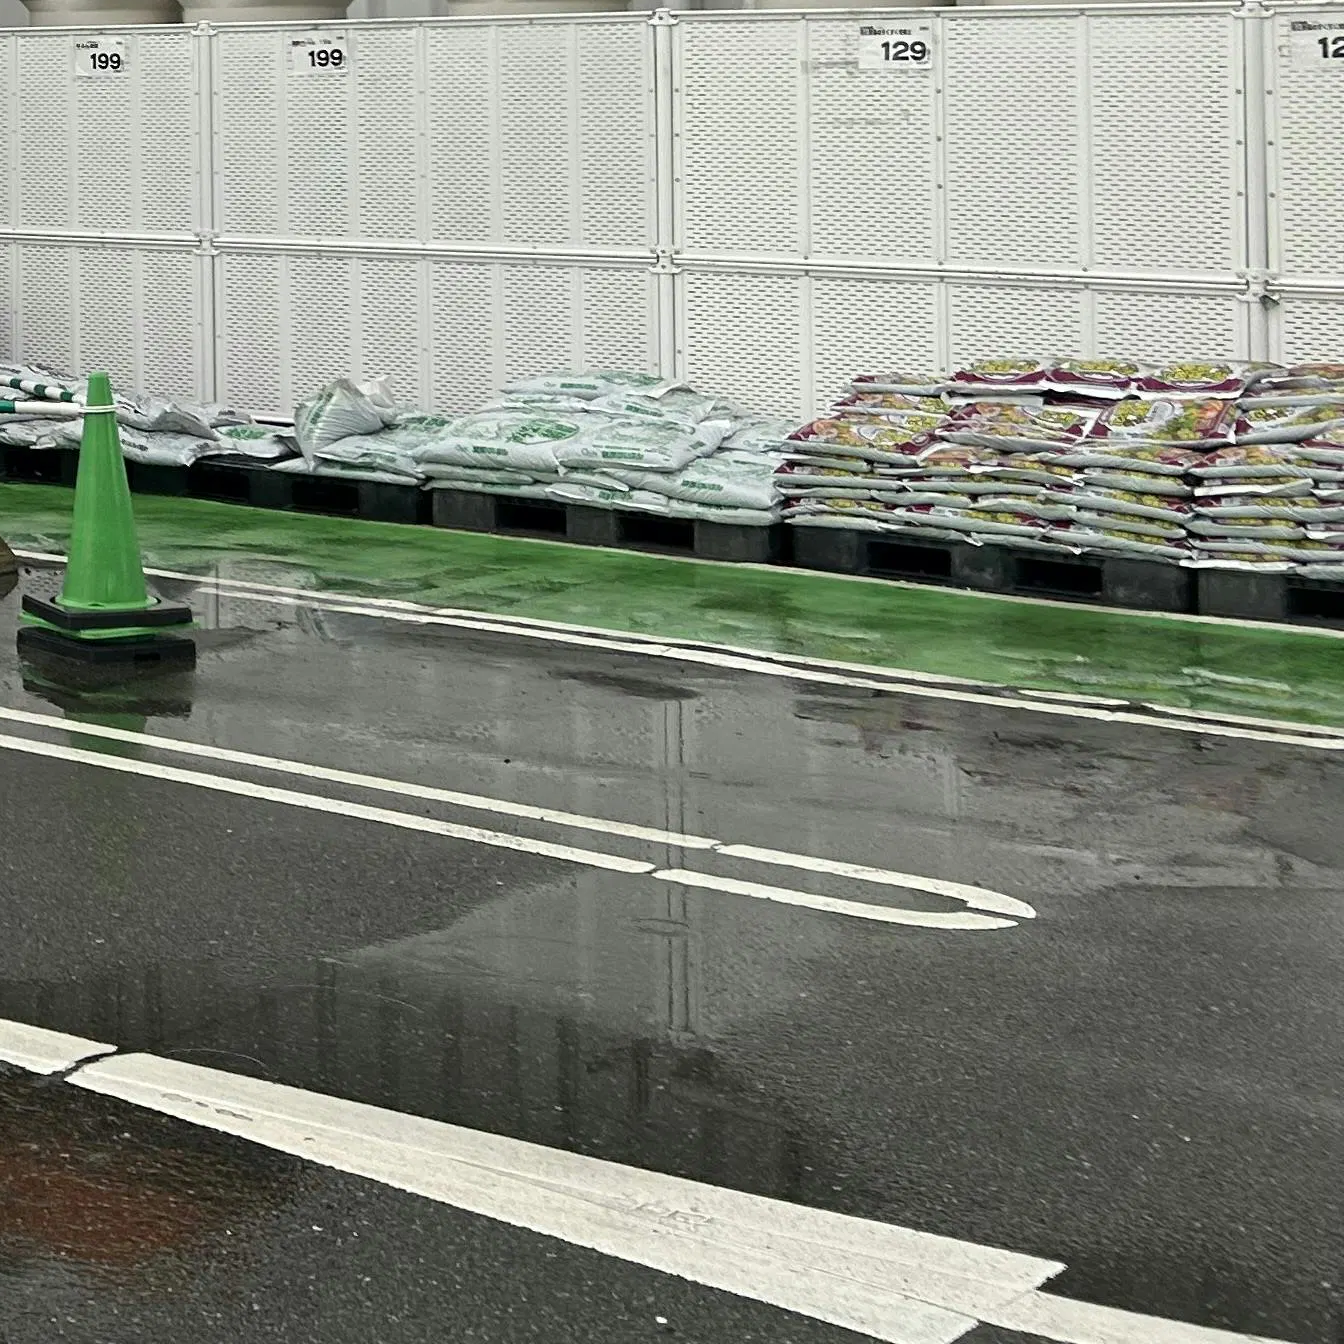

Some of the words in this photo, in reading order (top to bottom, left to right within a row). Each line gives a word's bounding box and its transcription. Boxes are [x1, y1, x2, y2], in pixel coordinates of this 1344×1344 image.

[308, 48, 343, 67] 199
[881, 41, 926, 61] 129
[90, 53, 121, 69] 199
